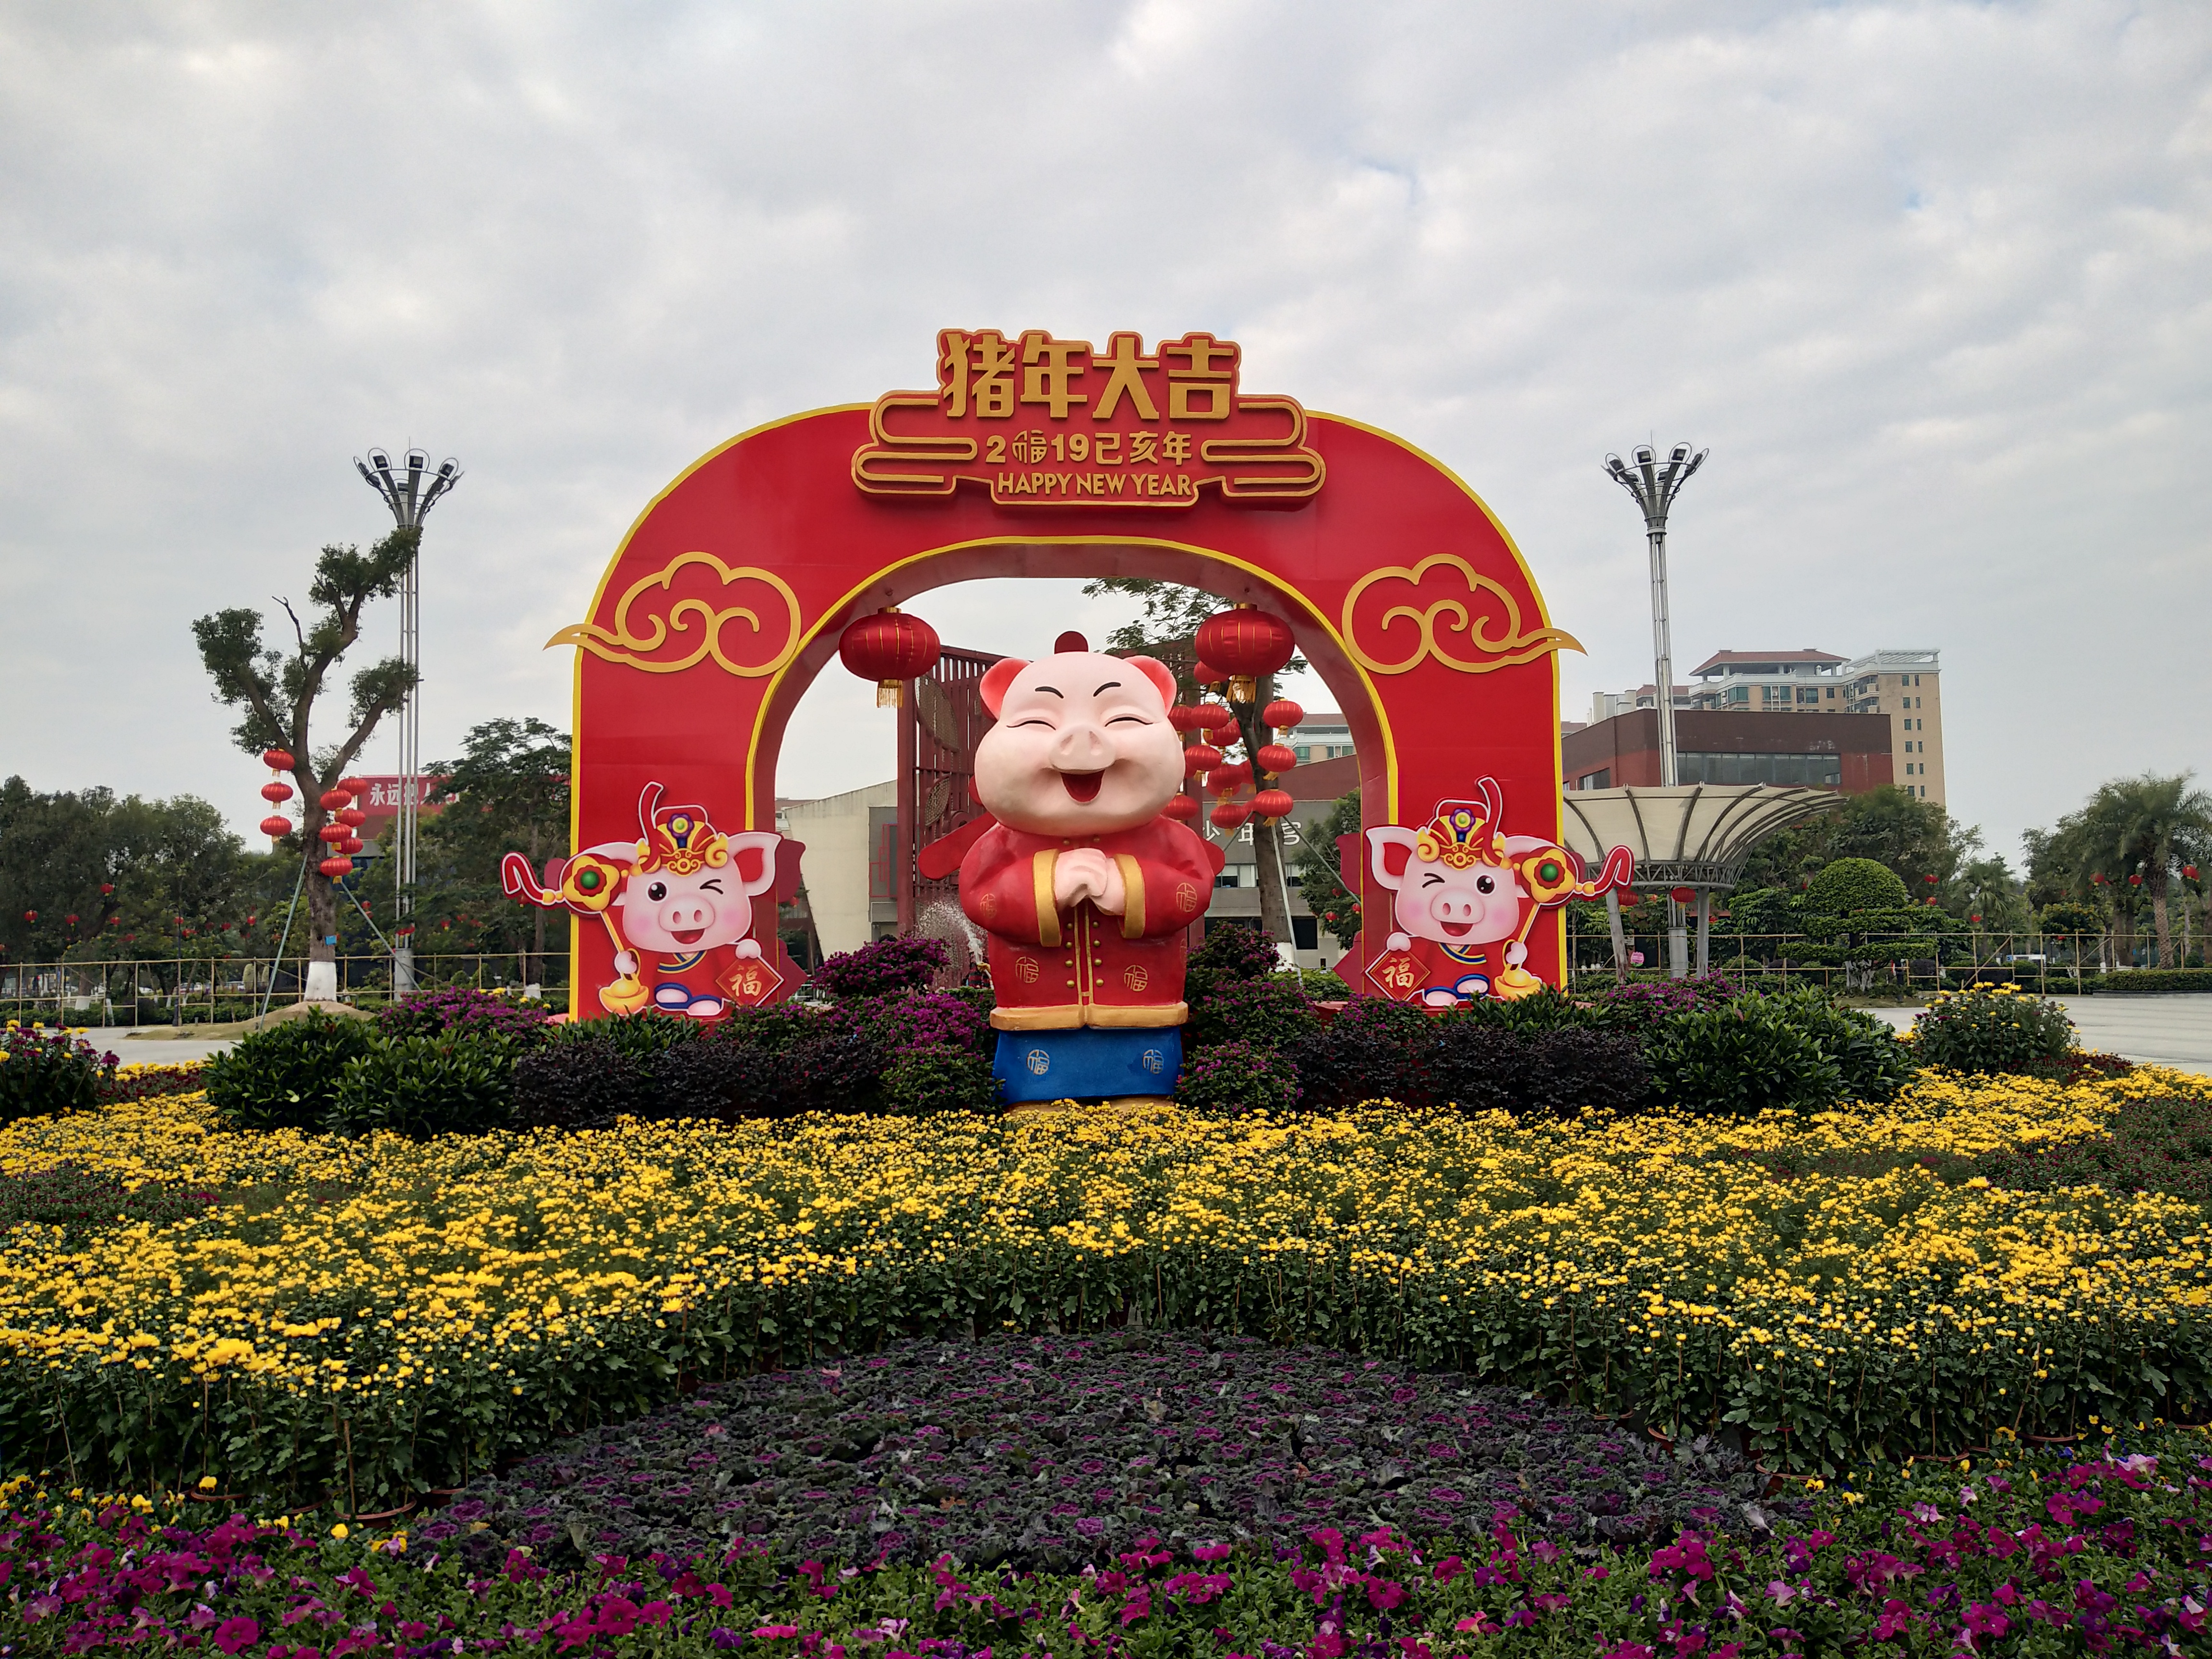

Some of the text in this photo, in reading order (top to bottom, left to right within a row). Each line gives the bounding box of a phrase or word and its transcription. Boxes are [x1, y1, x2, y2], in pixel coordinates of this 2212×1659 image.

[944, 333, 1234, 419] 猪年大吉
[998, 472, 1192, 496] HAPPY NEW YEAR
[1176, 882, 1197, 913] 福
[729, 965, 762, 997] 福
[1015, 956, 1039, 984] 福
[1123, 964, 1149, 992] 福
[1382, 957, 1415, 988] 福
[1027, 1049, 1050, 1075] 福
[1142, 1049, 1164, 1075] 福
